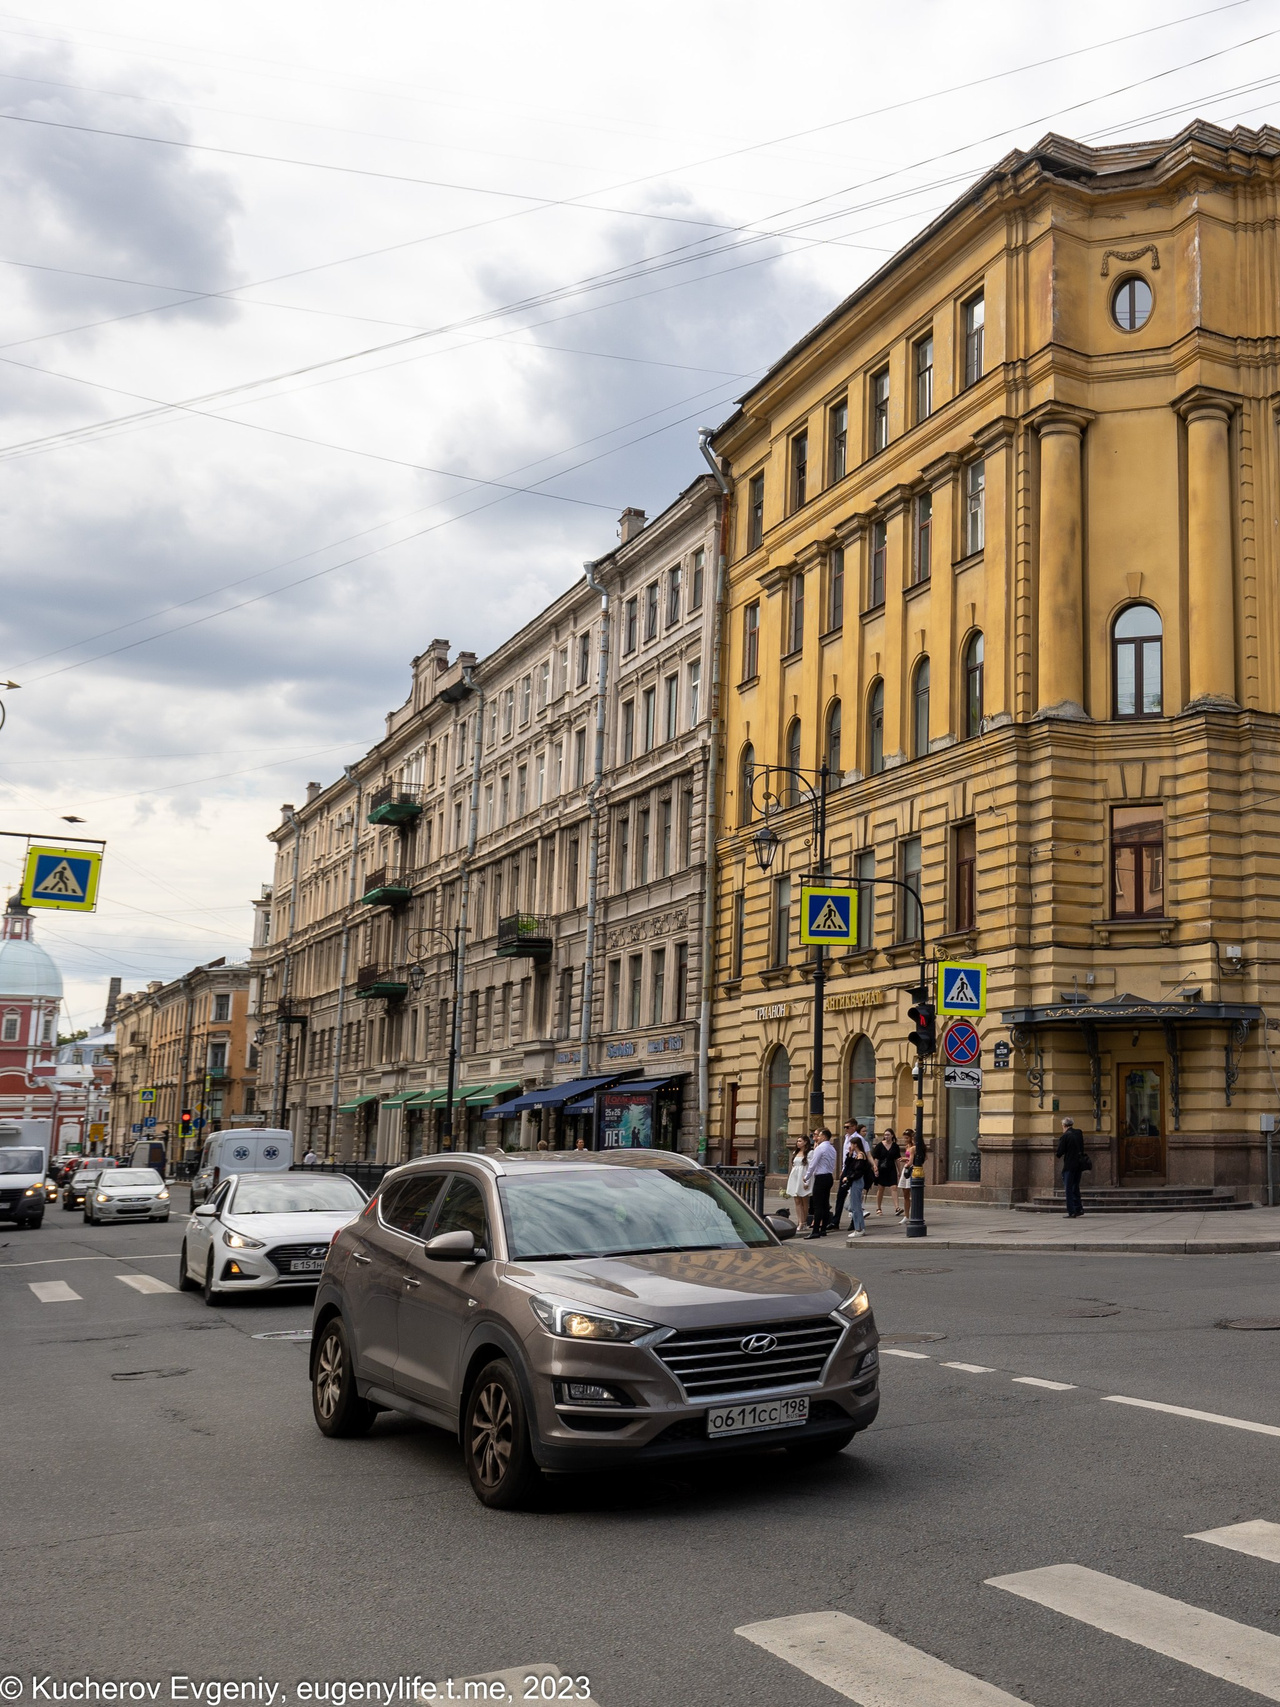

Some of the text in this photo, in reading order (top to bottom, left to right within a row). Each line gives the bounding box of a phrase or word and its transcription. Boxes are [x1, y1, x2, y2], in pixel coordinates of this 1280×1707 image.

[825, 990, 883, 1011] АНТИКВАРИАТ
[755, 1003, 788, 1021] ТРИАНОН
[604, 1130, 626, 1147] ЛЕС
[782, 1399, 806, 1414] 198
